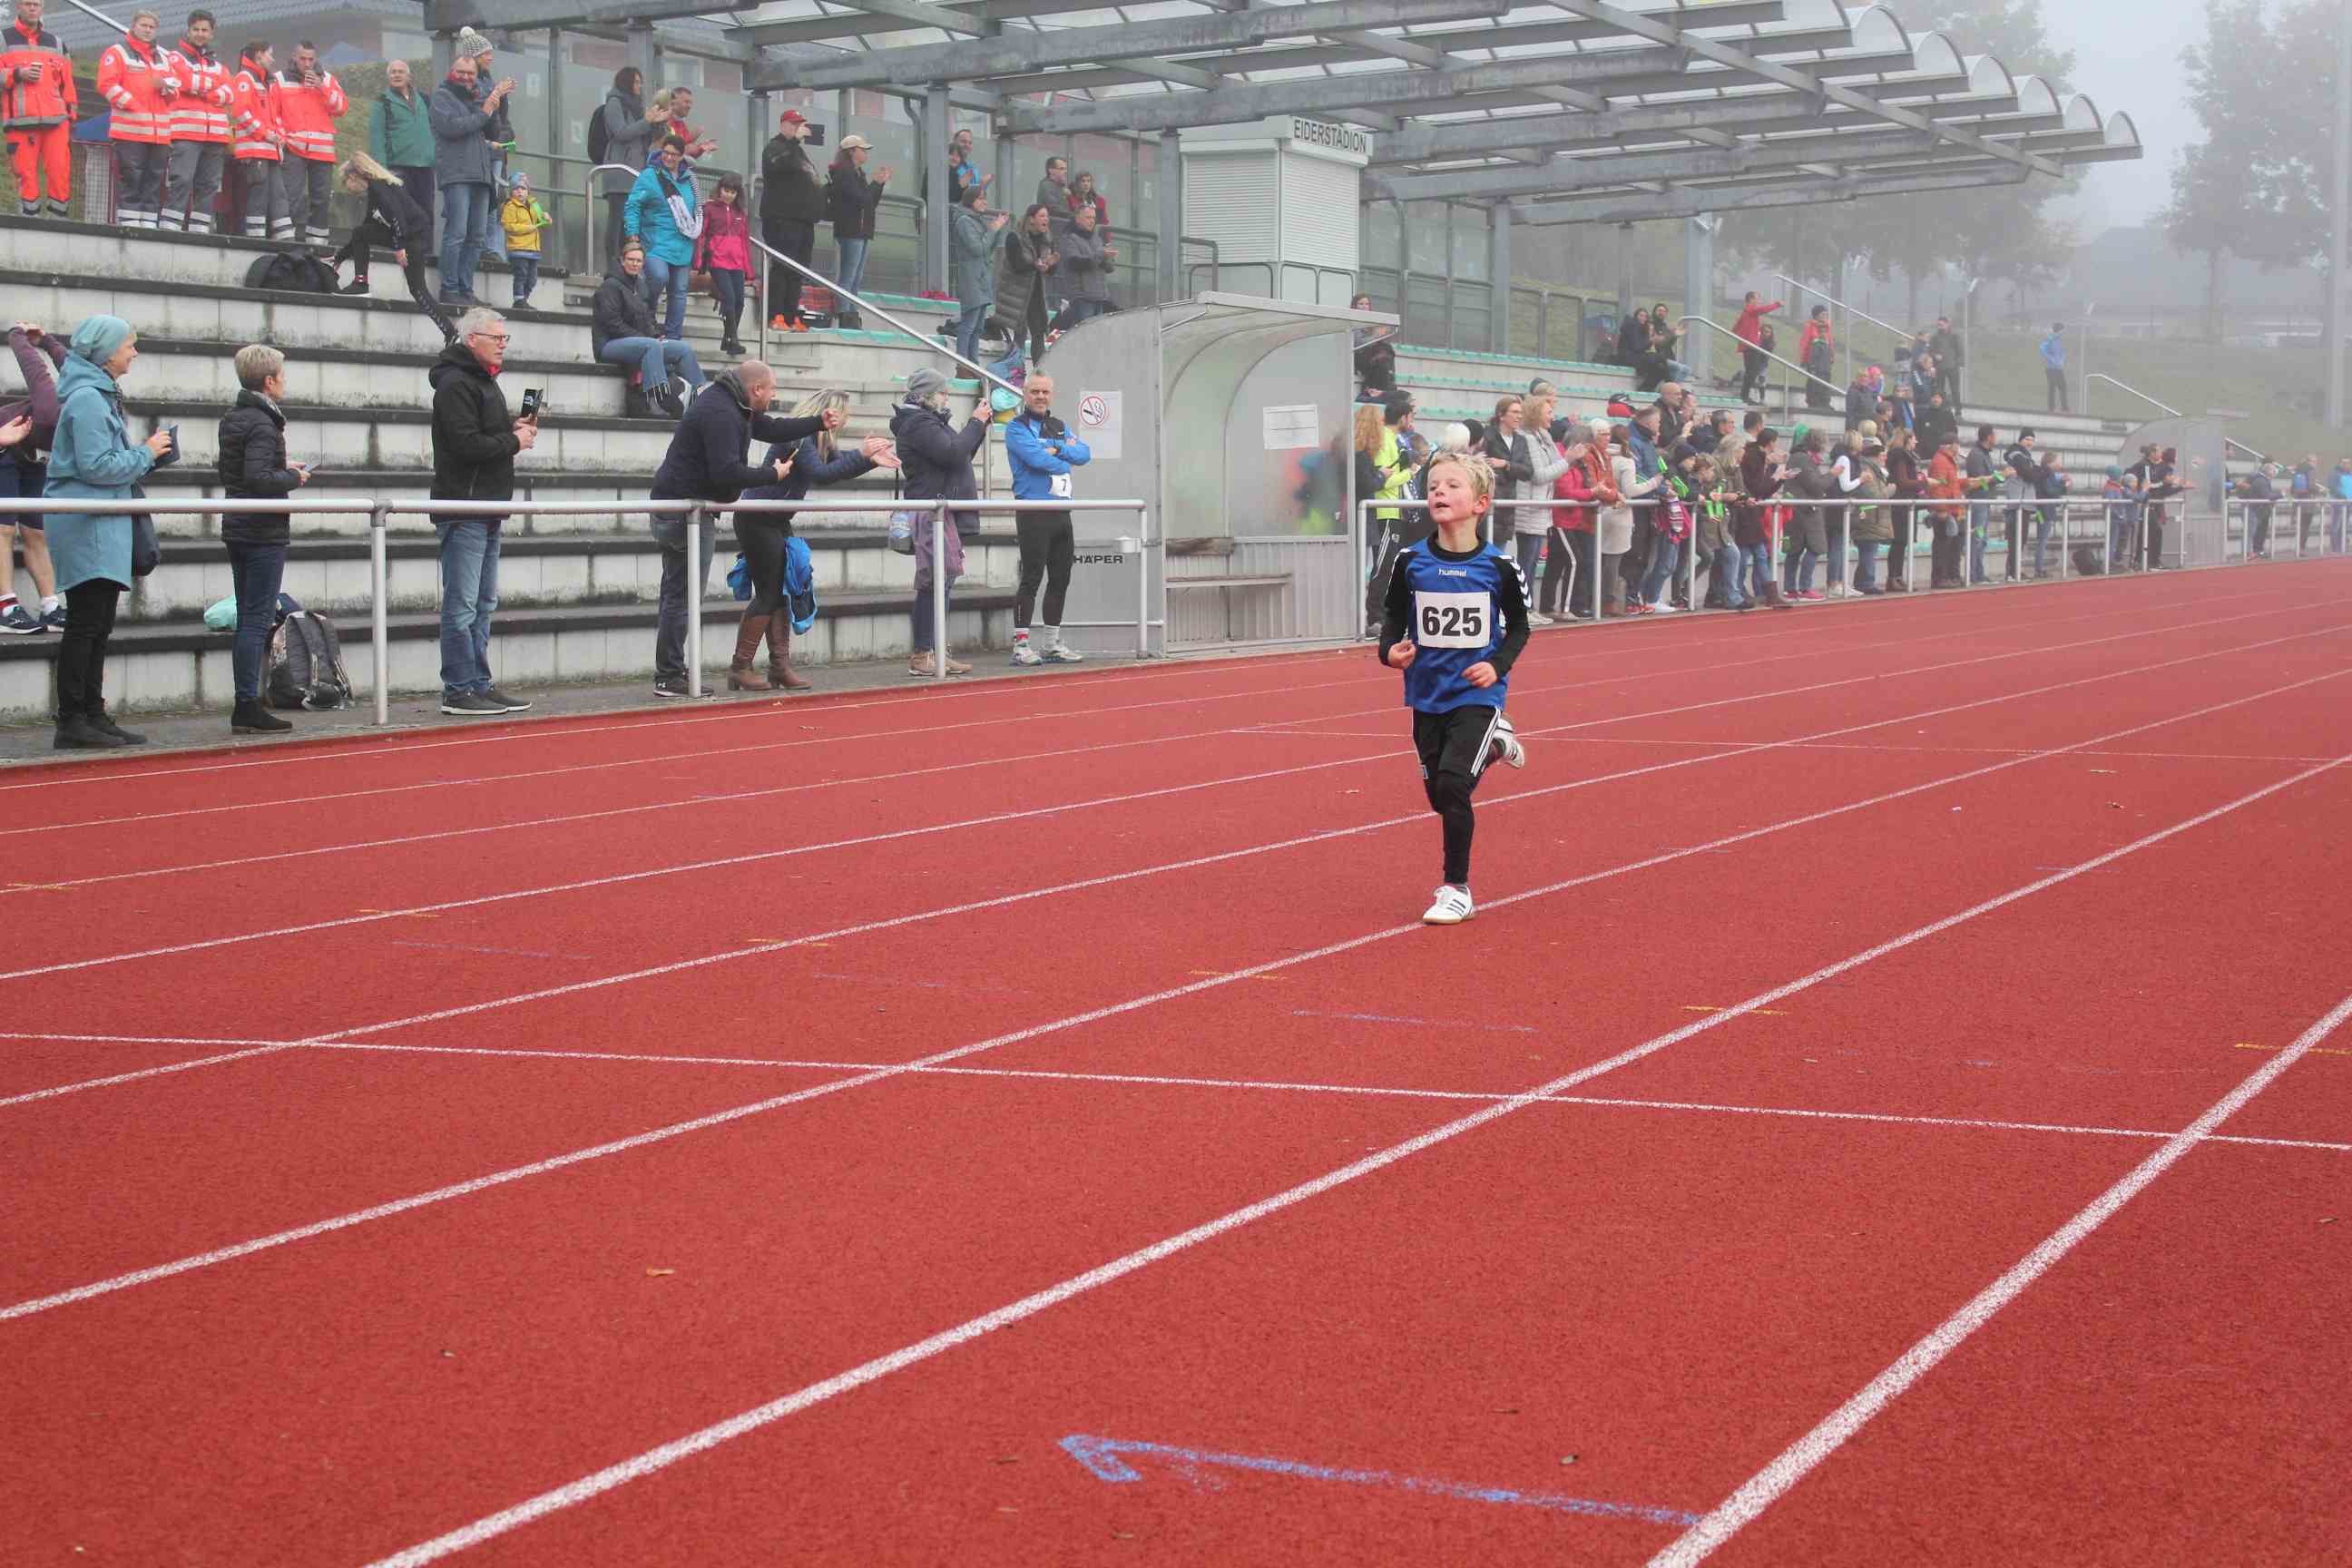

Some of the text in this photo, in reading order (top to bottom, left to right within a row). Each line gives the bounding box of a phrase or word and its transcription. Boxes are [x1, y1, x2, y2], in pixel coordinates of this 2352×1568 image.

[1293, 119, 1366, 152] EIDERSTADION
[1073, 554, 1124, 564] HÄPER
[1422, 606, 1482, 637] 625
